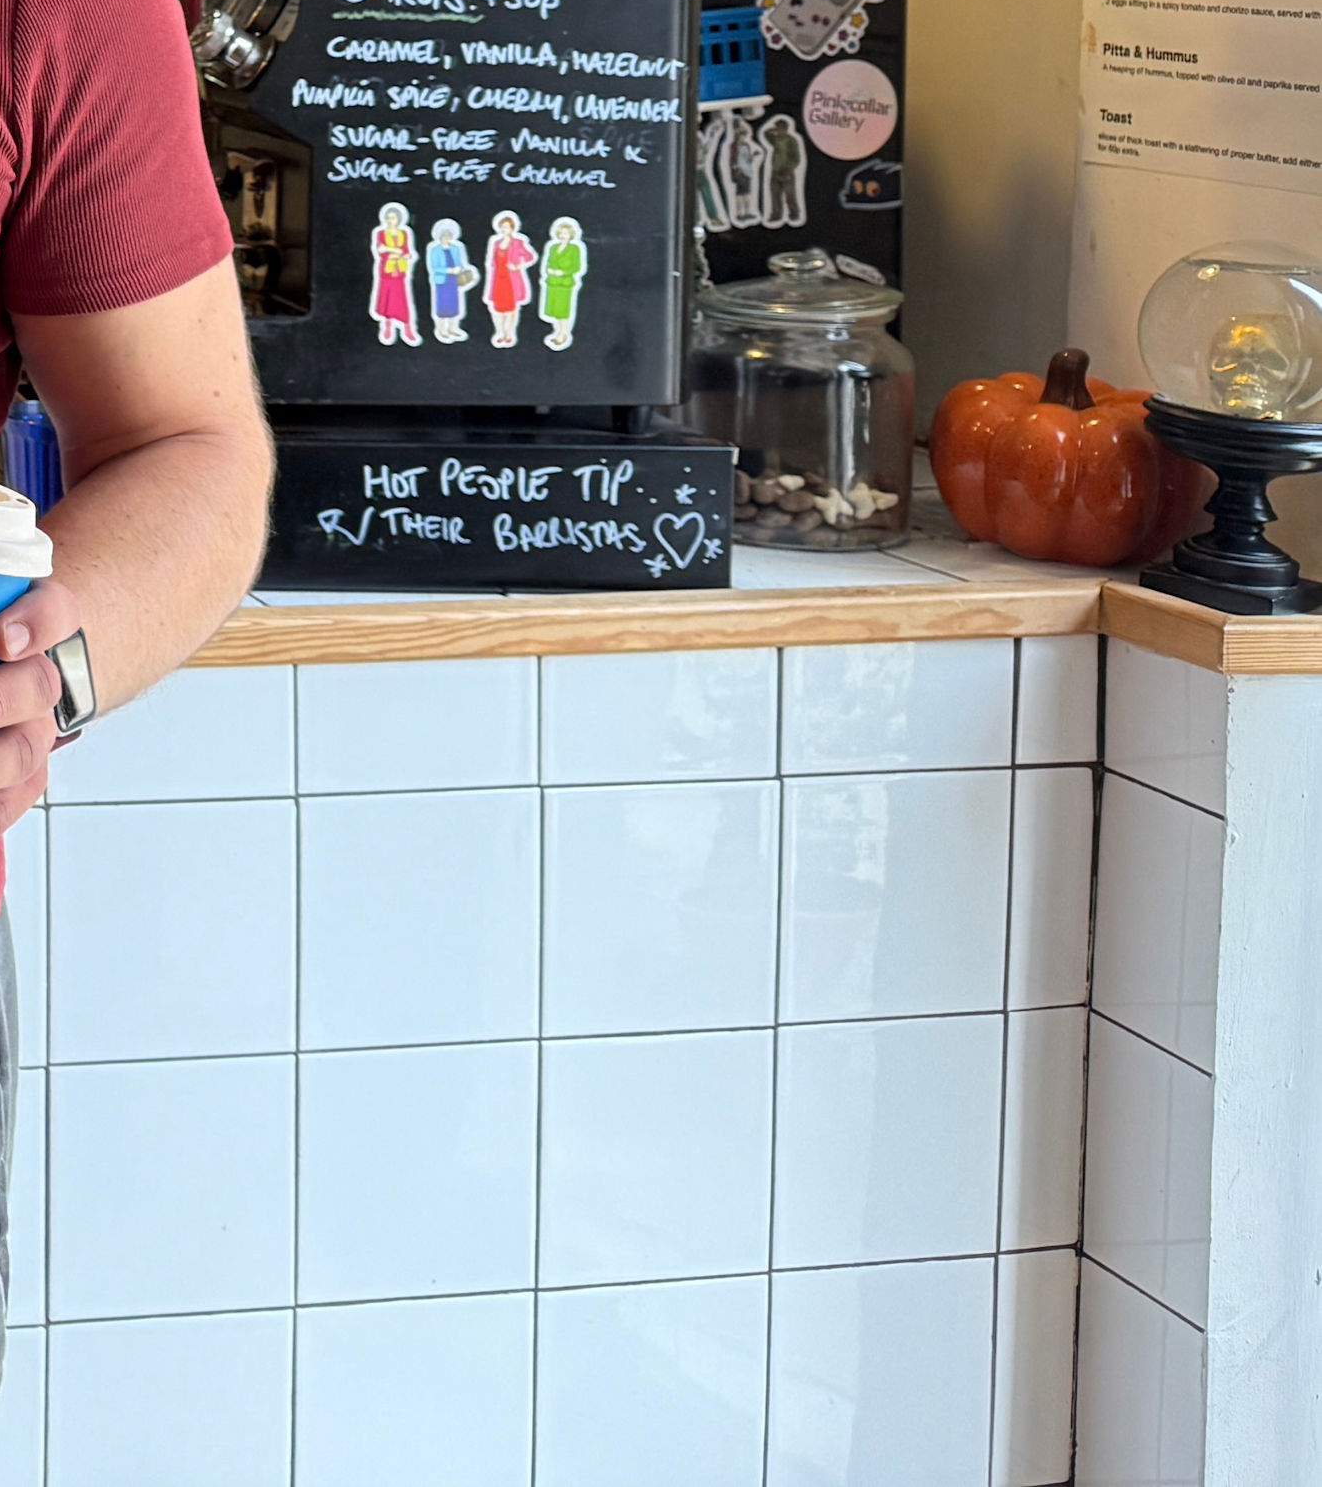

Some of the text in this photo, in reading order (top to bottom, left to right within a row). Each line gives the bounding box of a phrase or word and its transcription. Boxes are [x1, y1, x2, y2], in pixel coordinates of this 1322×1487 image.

[572, 50, 686, 81] HAZELNUT
[1103, 42, 1199, 64] Pitta & Hummus
[810, 108, 865, 132] Gallery
[1099, 108, 1133, 125] Toast
[510, 128, 612, 159] VANILLA
[501, 163, 617, 190] CARAMEL
[363, 464, 428, 500] HOT
[440, 457, 563, 503] PEOPLE
[380, 507, 471, 545] THEIR
